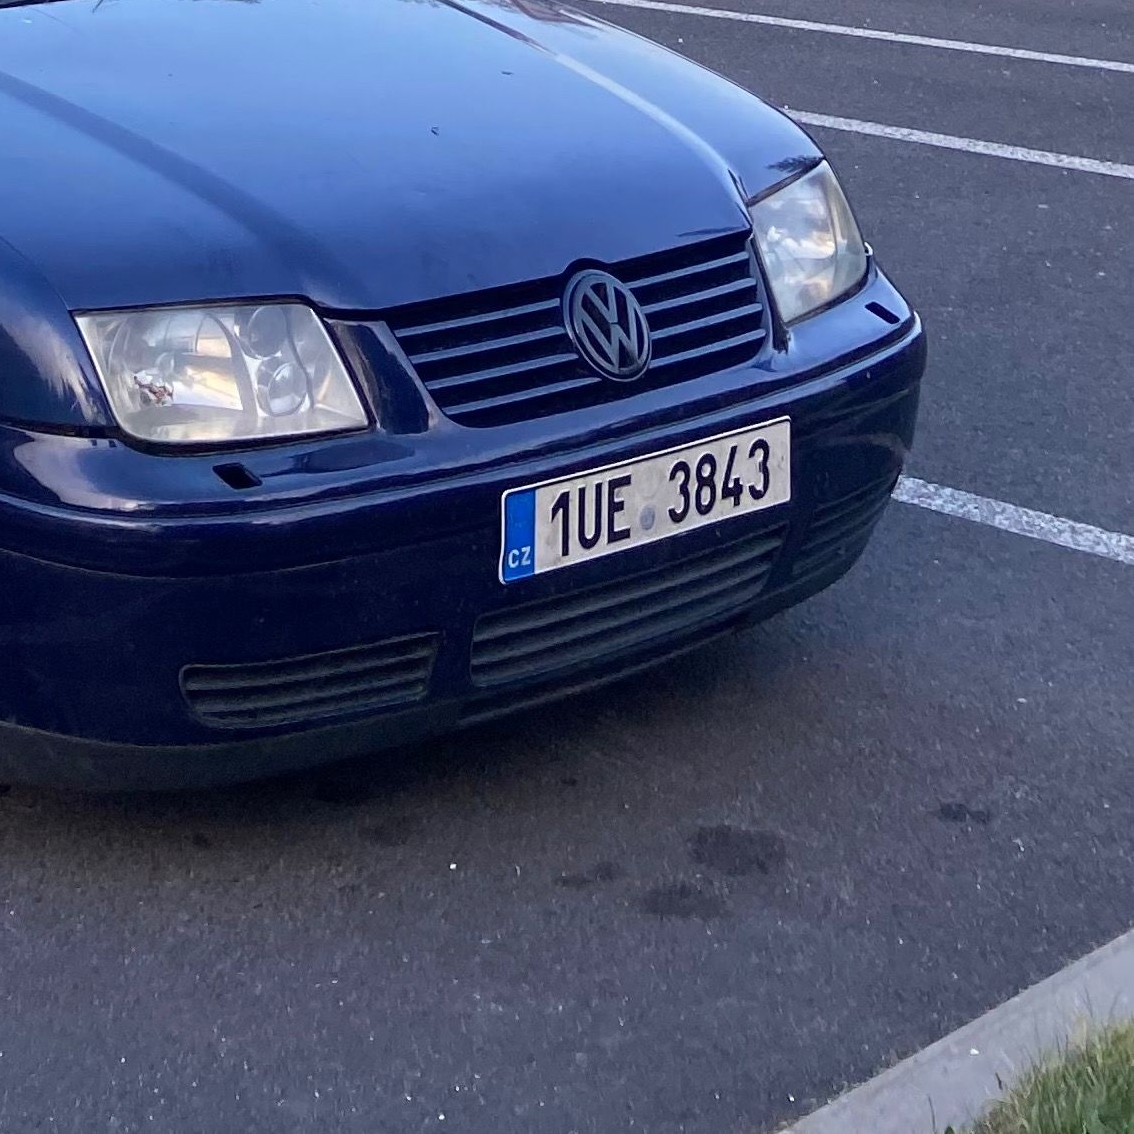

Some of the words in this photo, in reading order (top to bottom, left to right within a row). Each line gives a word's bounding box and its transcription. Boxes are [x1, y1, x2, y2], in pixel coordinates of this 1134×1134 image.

[572, 276, 650, 377] VW
[550, 474, 632, 557] 1UE
[668, 438, 770, 524] 3843
[508, 546, 531, 568] CZ
